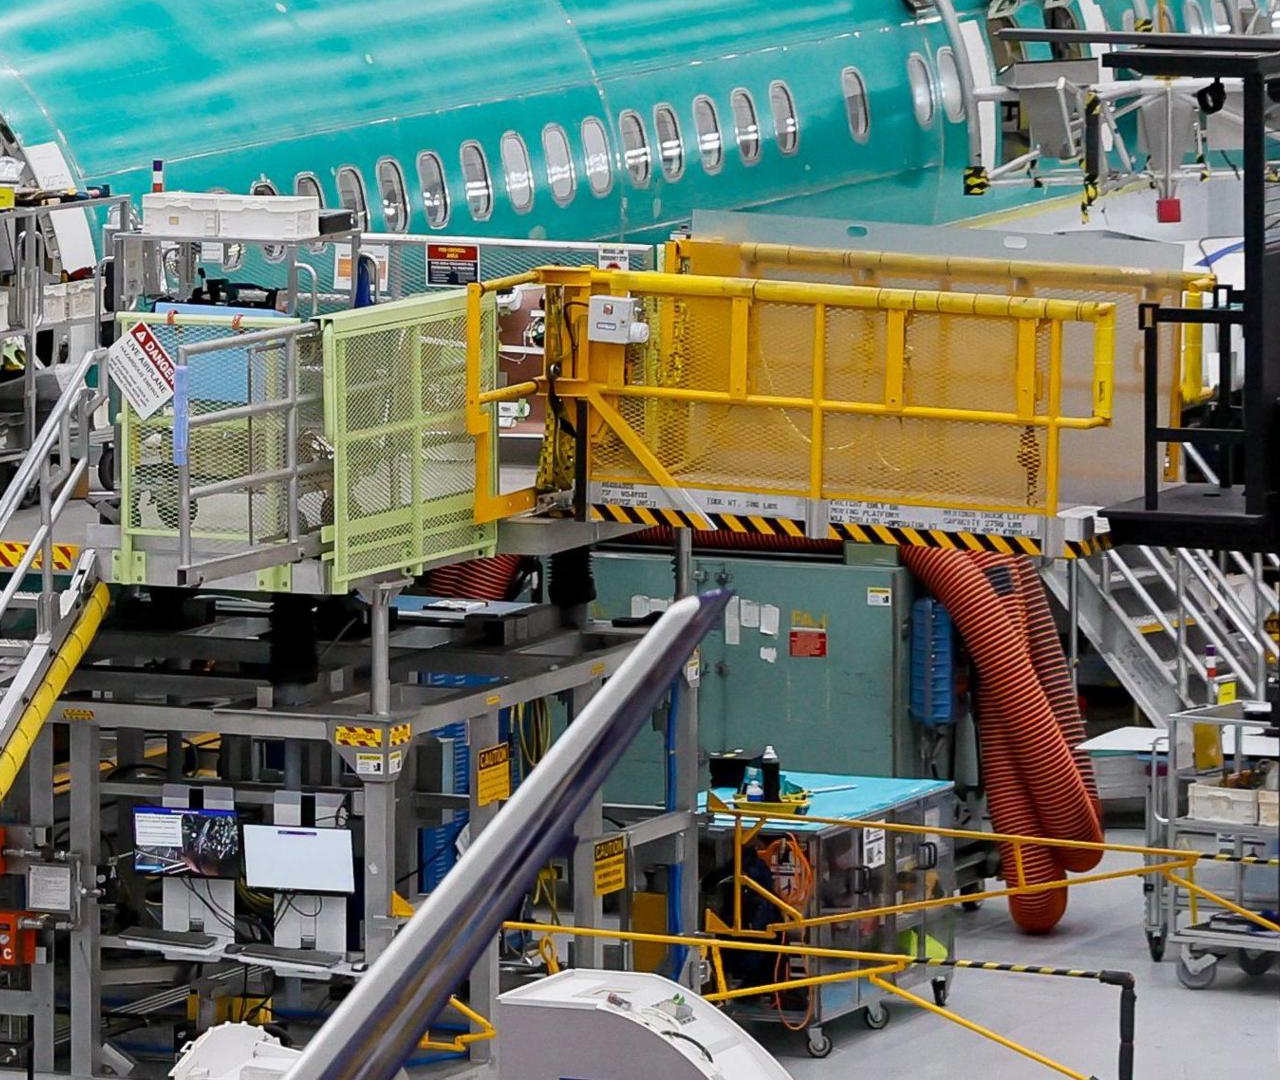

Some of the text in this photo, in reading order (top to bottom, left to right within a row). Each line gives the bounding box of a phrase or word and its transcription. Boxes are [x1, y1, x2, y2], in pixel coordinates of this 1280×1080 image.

[126, 339, 140, 355] LIVE
[139, 357, 167, 393] AIRPLANE
[480, 745, 508, 769] CAUTION
[594, 837, 624, 860] CAUTION
[3, 948, 12, 960] C
